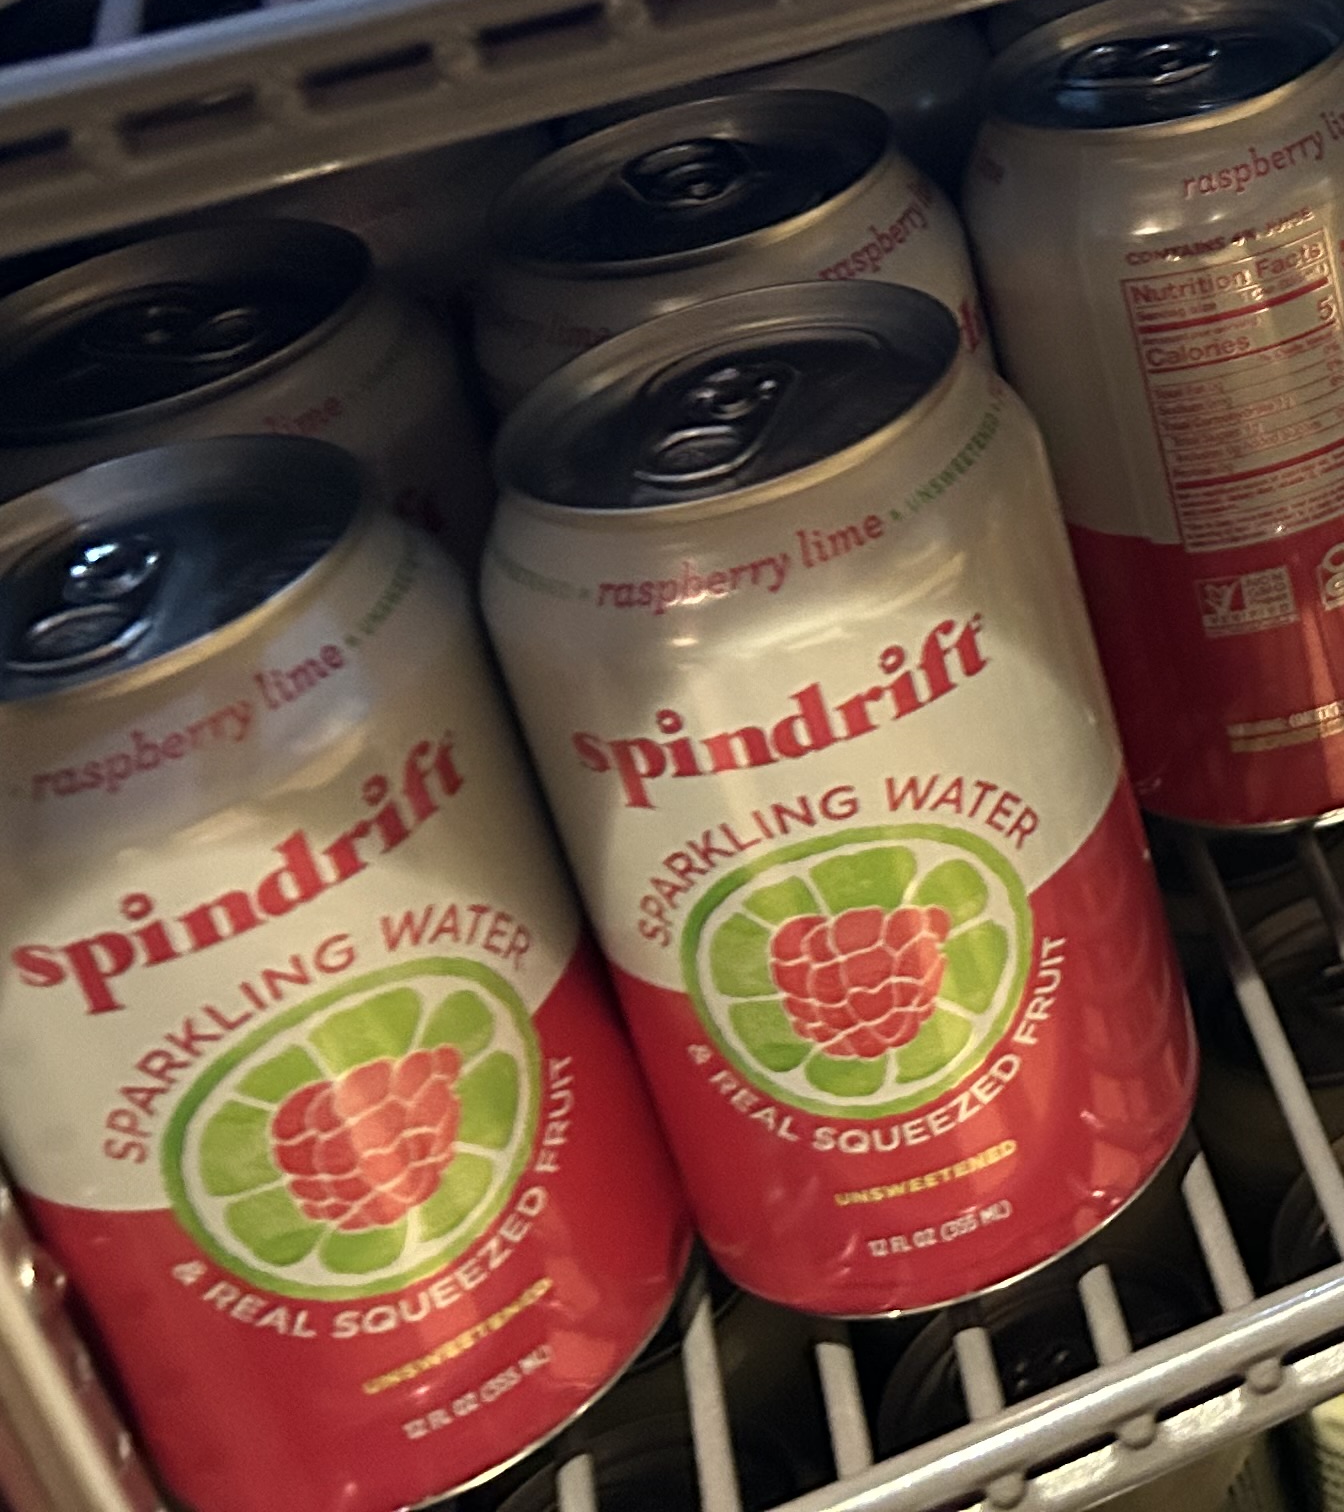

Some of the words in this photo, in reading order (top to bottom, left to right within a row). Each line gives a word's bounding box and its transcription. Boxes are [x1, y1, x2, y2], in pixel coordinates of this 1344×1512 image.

[1180, 132, 1325, 201] raspberry
[1130, 267, 1252, 305] Nutrition
[1253, 241, 1325, 278] Facts
[1145, 334, 1251, 368] Calories
[1315, 294, 1338, 322] 5
[596, 551, 792, 615] raspberry
[799, 511, 886, 571] lime
[31, 700, 257, 804] raspberry
[253, 642, 347, 713] lime
[570, 612, 992, 810] spindrift
[10, 728, 467, 1016] spindrift
[638, 783, 861, 948] SPARKLING
[884, 772, 1041, 851] WATER
[103, 932, 358, 1165] SPARKLING
[379, 901, 533, 974] WATER
[686, 1042, 713, 1067] &
[709, 1068, 800, 1144] REAL
[810, 1051, 1022, 1155] SQUEEZED
[1012, 935, 1068, 1046] FRUIT
[171, 1257, 206, 1289] &
[201, 1276, 318, 1339] REAL
[331, 1184, 548, 1340] SQUEEZED
[533, 1055, 574, 1174] FRUIT
[833, 1138, 1018, 1208] UNSWEETENED
[867, 1236, 888, 1257] 12
[889, 1232, 911, 1254] FL
[912, 1224, 938, 1248] OZ
[939, 1210, 979, 1244] (355
[361, 1276, 555, 1395] UNSWEETENED
